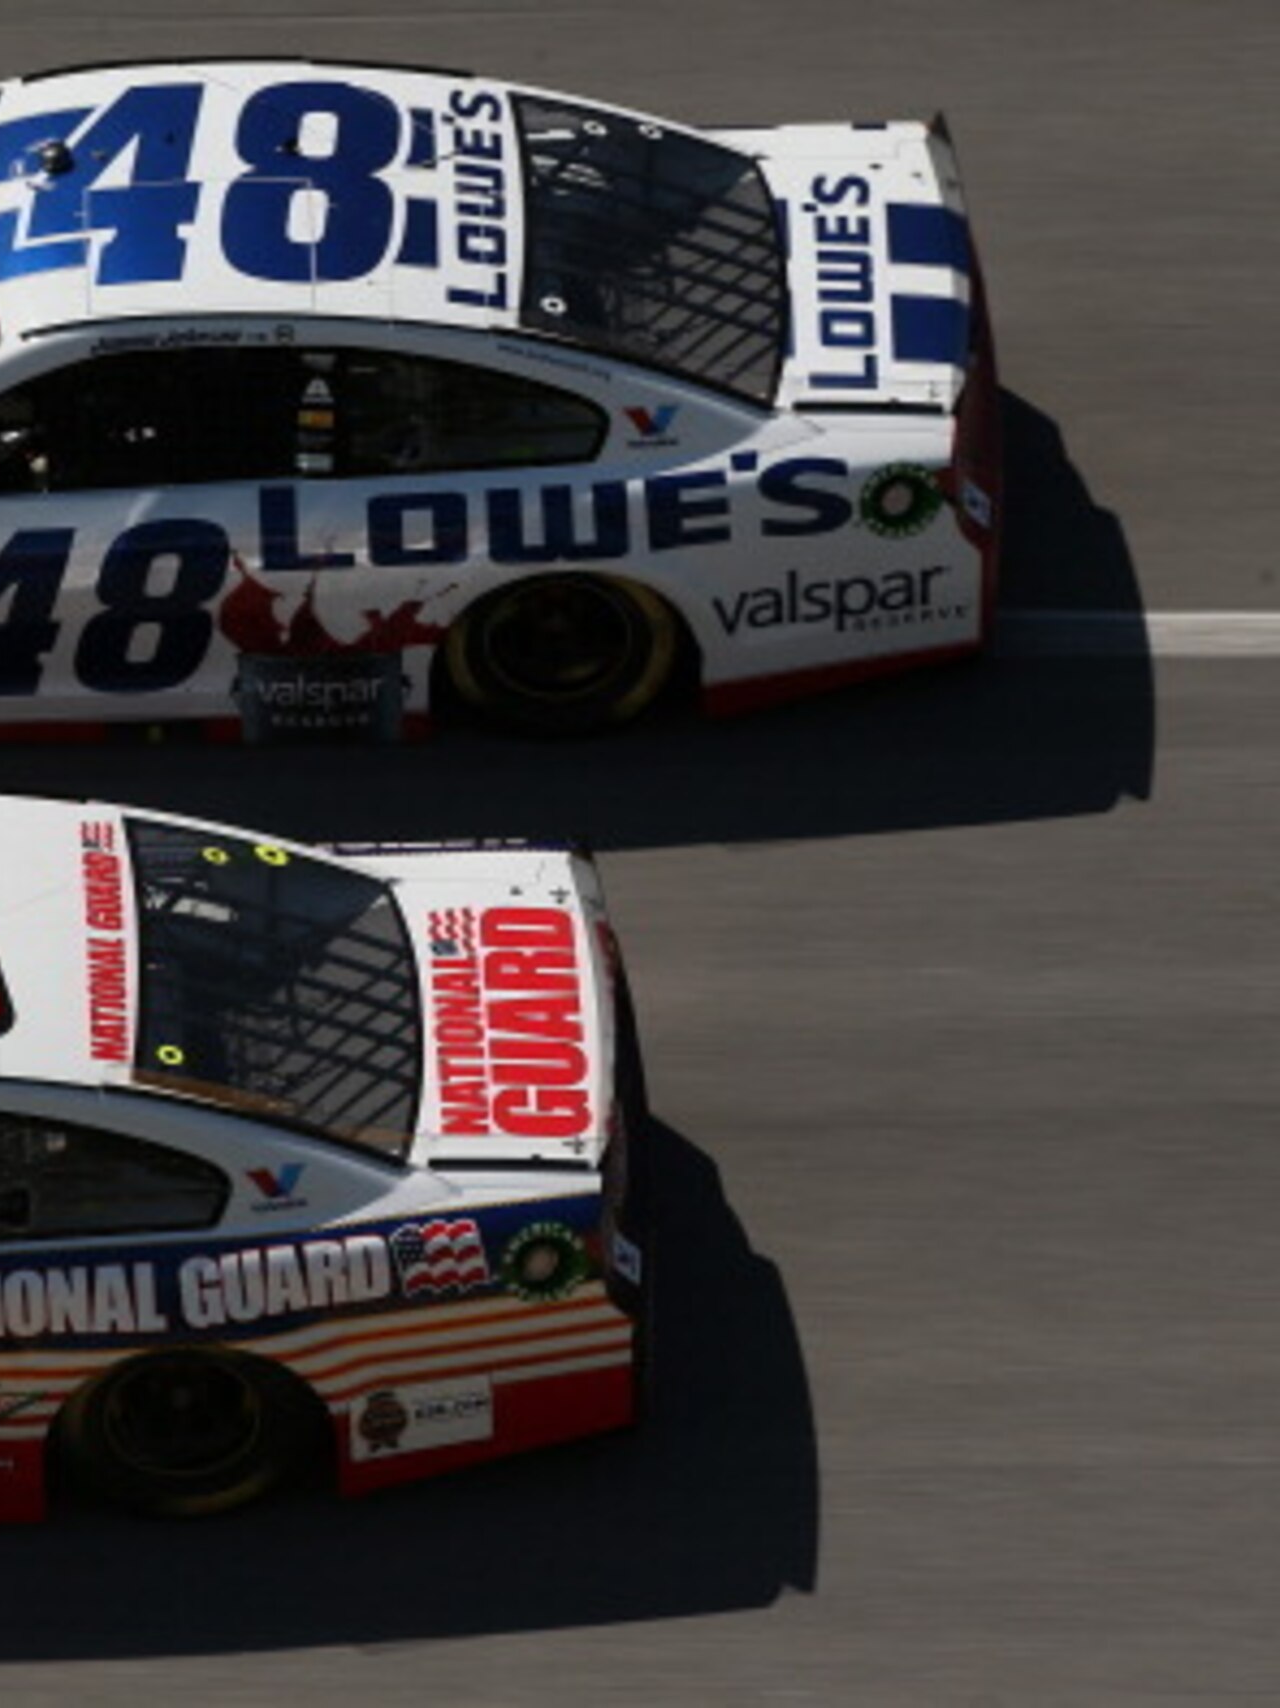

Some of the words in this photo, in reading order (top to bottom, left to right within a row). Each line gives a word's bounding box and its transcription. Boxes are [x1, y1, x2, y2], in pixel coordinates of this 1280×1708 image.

[27, 81, 401, 285] 48
[444, 88, 507, 310] LOWE'S
[802, 174, 879, 389] LOWE'S
[258, 452, 853, 571] LOWE'S
[712, 566, 951, 637] valspar
[259, 672, 383, 713] valspar
[82, 852, 124, 932] GUARD
[87, 938, 129, 1061] NATIONAL
[429, 955, 489, 1135] NATIONAL
[478, 906, 593, 1137] GUARD
[178, 1233, 393, 1329] GUARD
